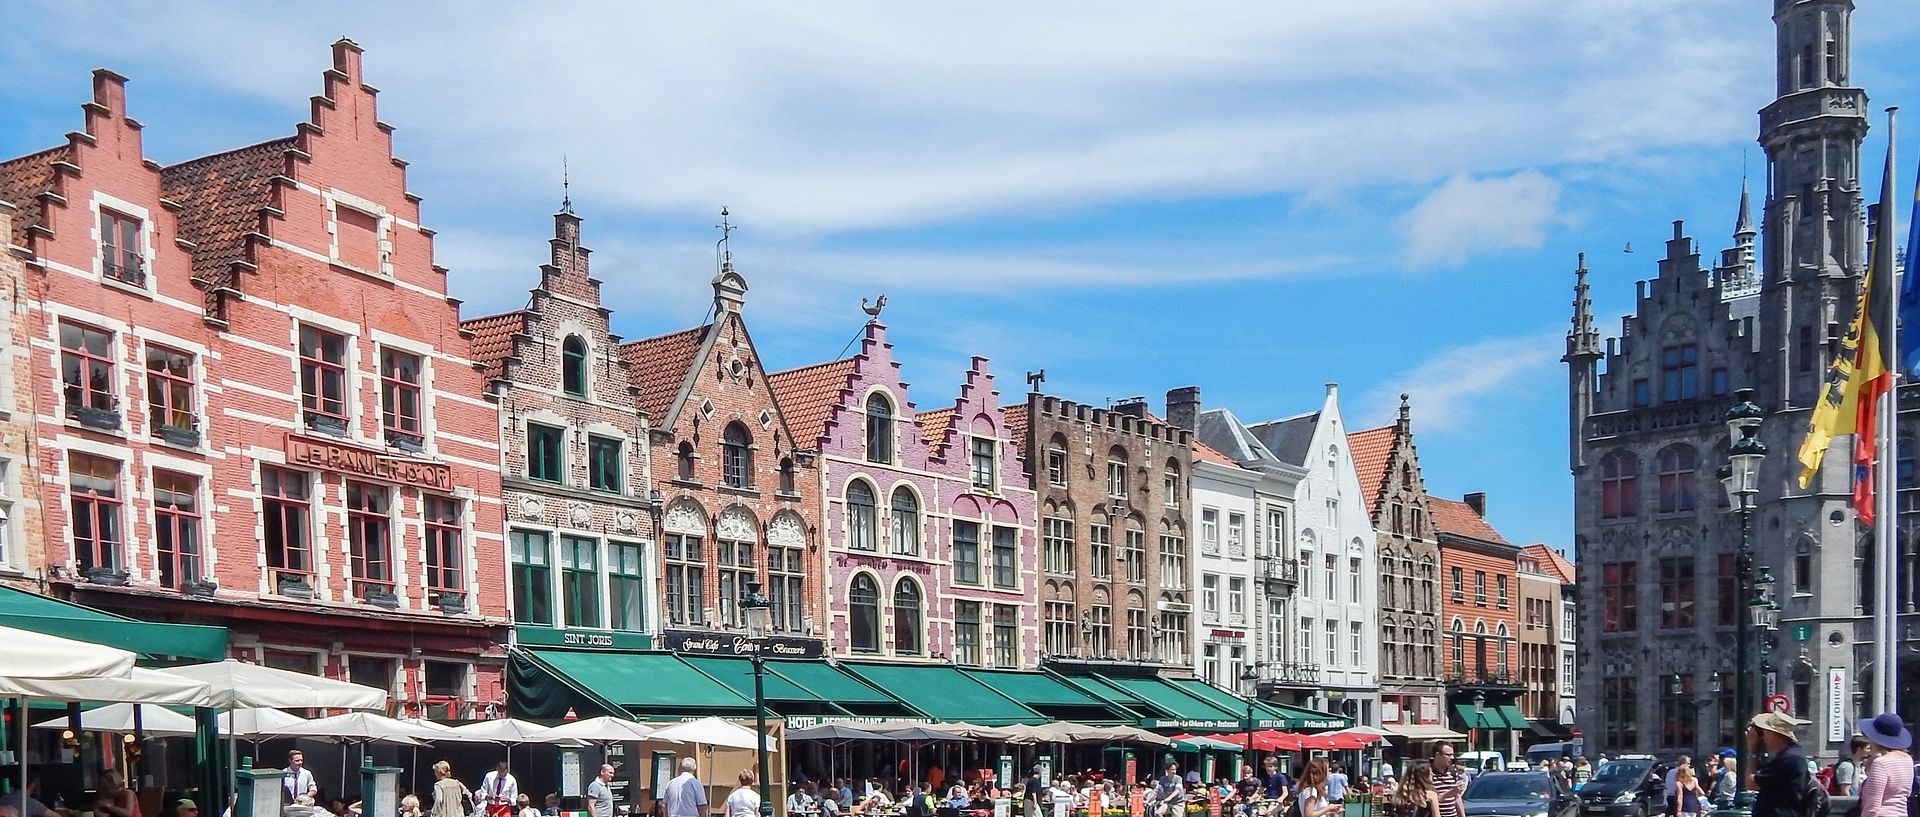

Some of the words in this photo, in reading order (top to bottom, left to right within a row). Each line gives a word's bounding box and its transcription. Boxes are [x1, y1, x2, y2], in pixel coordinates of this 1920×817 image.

[295, 443, 322, 465] LE
[328, 445, 400, 479] PANIER
[406, 463, 448, 488] D'OR
[564, 633, 585, 644] SINT
[587, 634, 612, 645] JORIS
[683, 638, 705, 651] Grand
[1833, 683, 1841, 735] HISTORIUM
[787, 717, 816, 728] HOTEL
[822, 717, 883, 725] REURANT
[1259, 720, 1272, 728] PETIT
[1304, 720, 1328, 728] Friterie
[1328, 720, 1345, 728] 1900
